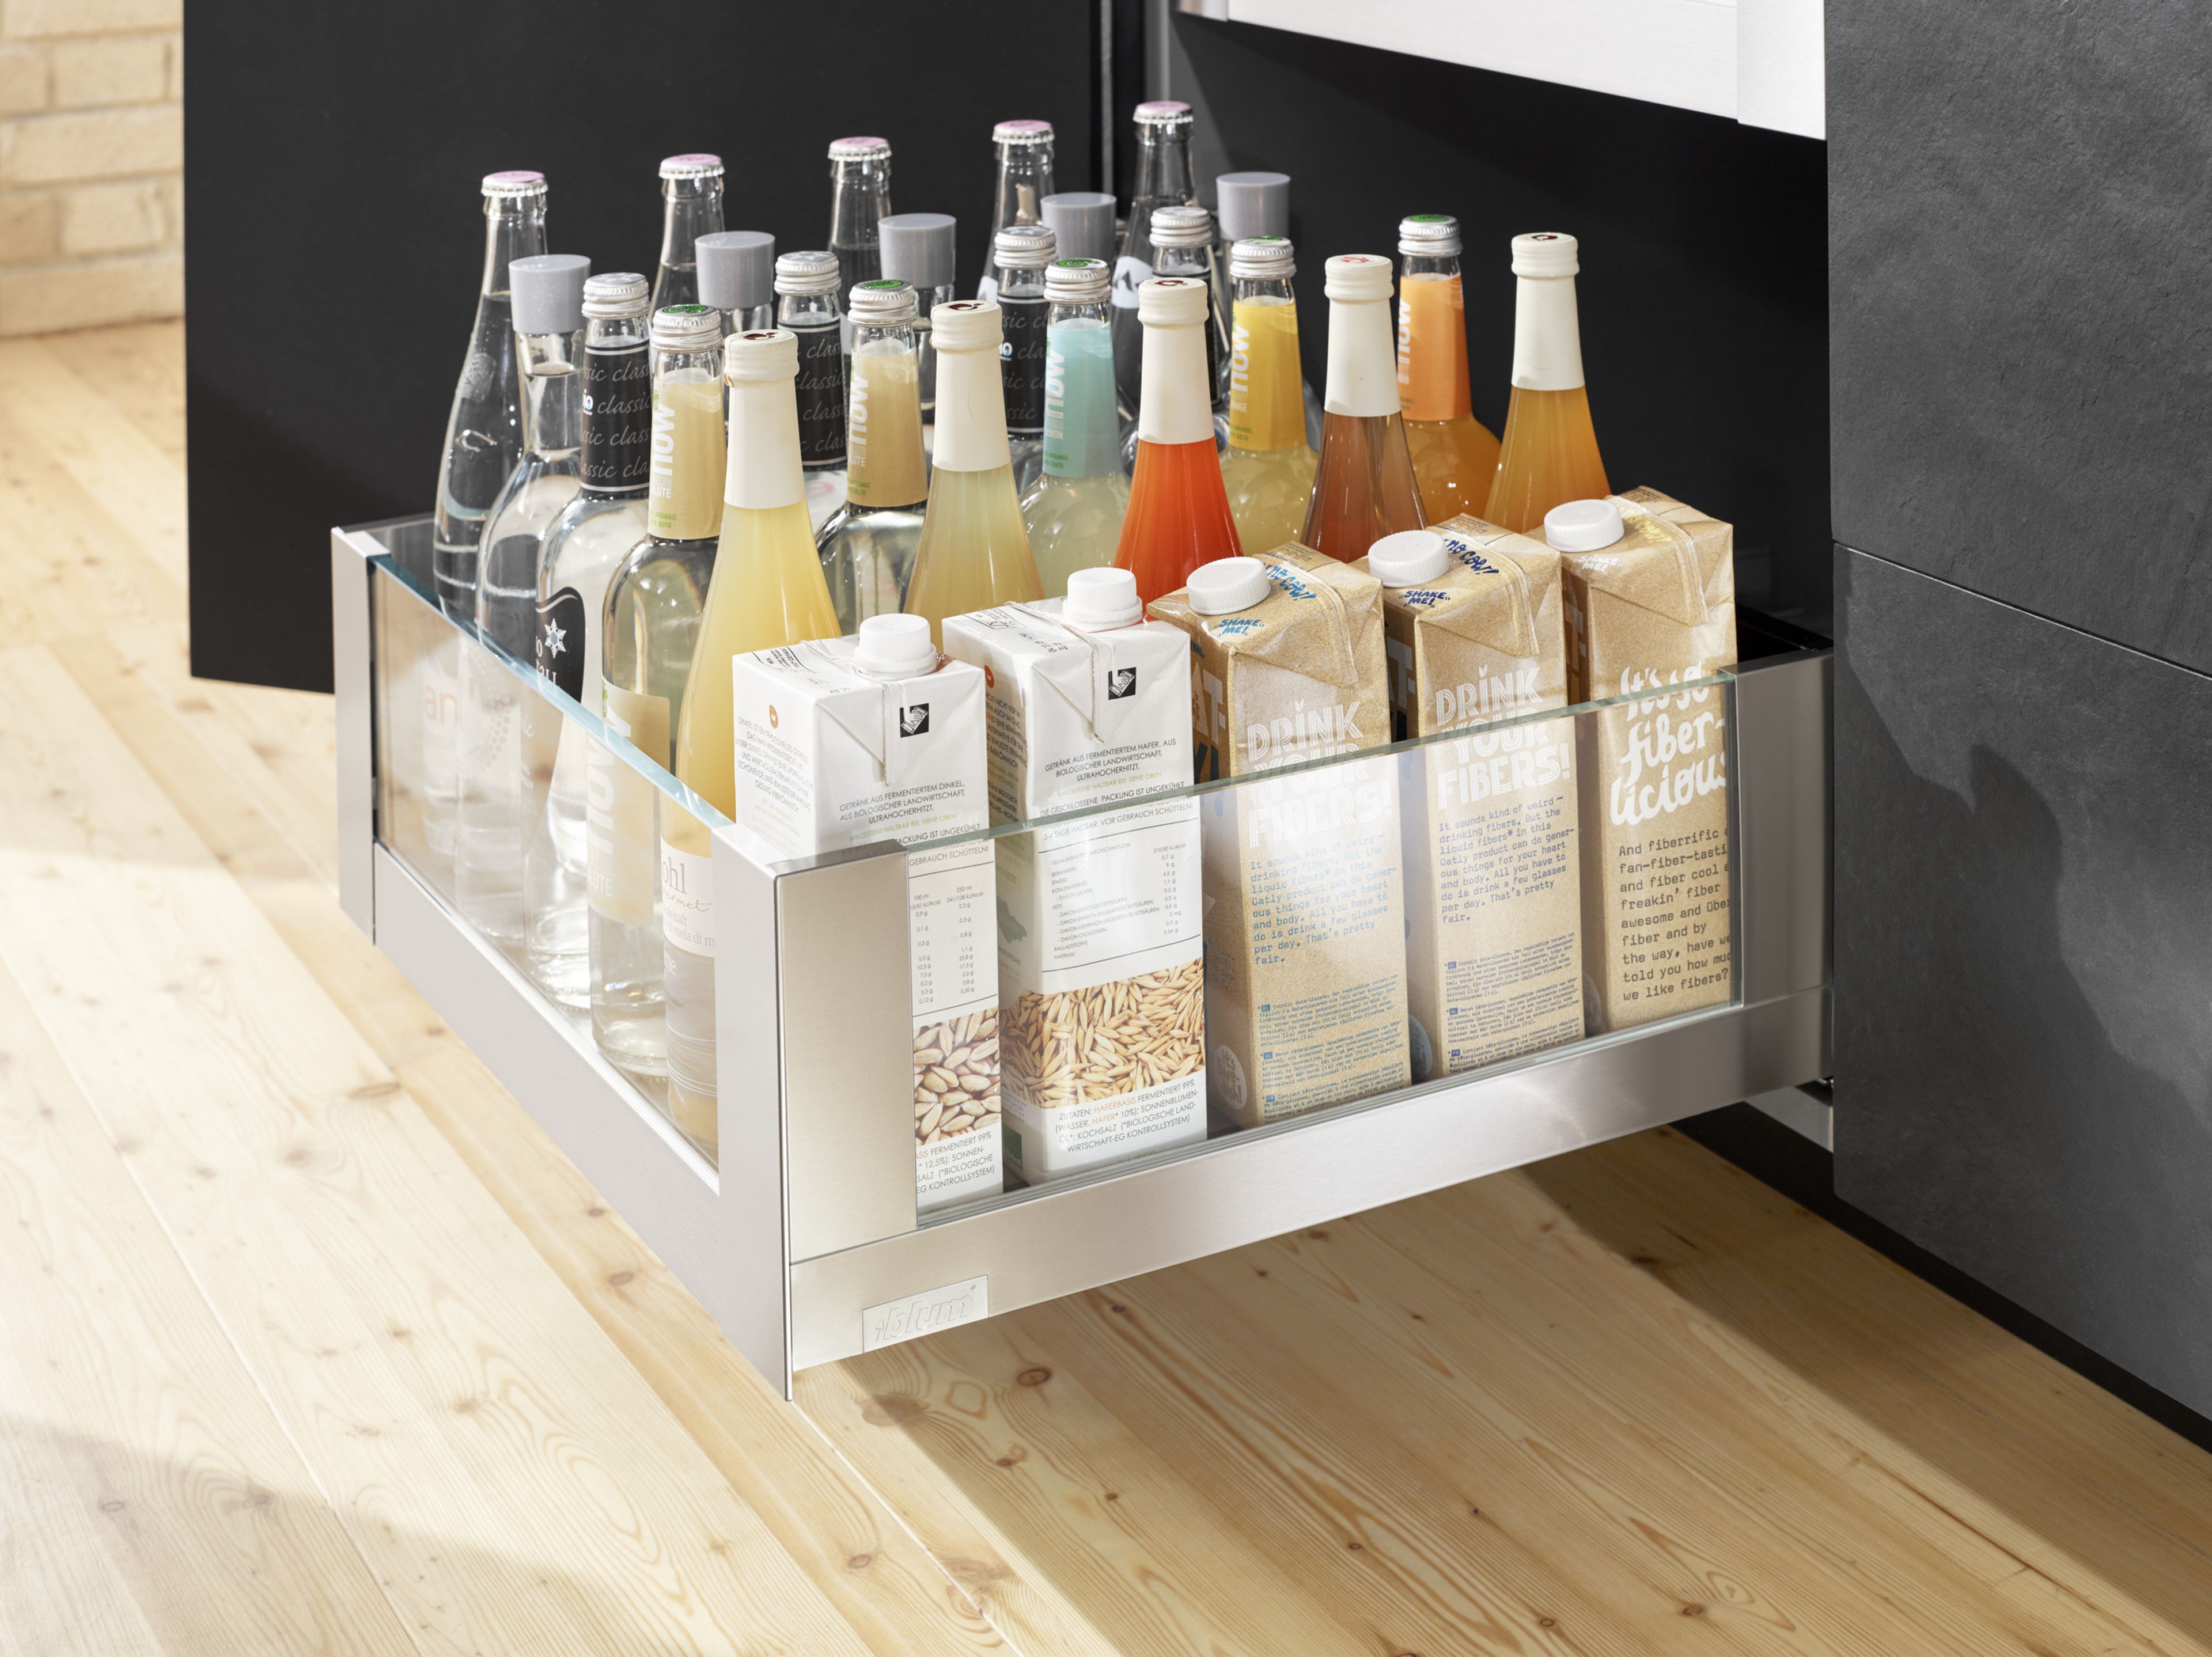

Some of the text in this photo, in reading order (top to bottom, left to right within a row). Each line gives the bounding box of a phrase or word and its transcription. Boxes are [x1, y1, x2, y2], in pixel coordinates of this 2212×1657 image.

[1404, 591, 1446, 599] SHAKE
[1222, 626, 1249, 634] ME!
[1436, 664, 1543, 726] DRINK
[1247, 699, 1363, 763] DRINK
[1045, 757, 1071, 772] GETRÄNK
[1073, 754, 1084, 763] AUS
[1086, 745, 1137, 760] FERMENTIERTEM
[1056, 761, 1101, 778] BIOLOGISCHER
[1077, 763, 1140, 781] ULTRAHOCHERHITZT.
[1438, 743, 1571, 810] FIBERS!
[840, 798, 869, 812] GETRÄNK
[870, 794, 884, 803] AUS
[885, 784, 938, 801] FERMENTIERTEM
[1101, 790, 1135, 802] PACKUNG
[1146, 782, 1184, 794] UNGEKÜHLT
[840, 812, 853, 822] AUS
[854, 801, 902, 818] BIOLOGISCHER
[869, 804, 934, 824] ULTRAHOCHERHITZT.
[1117, 809, 1154, 823] GEBRAUCH
[1455, 816, 1486, 829] sounds
[1489, 809, 1510, 820] kind
[1513, 804, 1523, 813] of
[930, 830, 938, 838] IST
[940, 824, 980, 836] UNGEKÜHLT
[1440, 828, 1483, 843] drinking
[1546, 807, 1560, 817] the
[1440, 842, 1474, 855] liquid
[1531, 822, 1552, 833] this
[1473, 844, 1508, 862] product
[1513, 841, 1528, 850] can
[1532, 836, 1542, 845] do
[1619, 829, 1719, 856] And fiberrific
[909, 850, 948, 867] GEBRAUCH
[1441, 841, 1566, 878] ous things for your heart
[1441, 854, 1566, 889] and body. All you have to
[1441, 893, 1453, 901] do
[1458, 889, 1469, 898] is
[1474, 882, 1500, 895] drink
[1513, 874, 1528, 885] few
[1532, 865, 1566, 881] glasses
[1620, 864, 1719, 892] and fiber cool
[1442, 903, 1459, 914] per
[1464, 898, 1486, 909] day.
[1525, 879, 1554, 896] pretty
[1687, 883, 1720, 899] fiber
[1442, 913, 1471, 924] fair.
[1622, 912, 1674, 928] awesome
[1680, 905, 1701, 918] and
[1623, 922, 1707, 947] fiber and by
[1623, 953, 1646, 965] the
[1652, 948, 1680, 961] way,
[1687, 938, 1714, 953] have
[1623, 969, 1654, 983] told
[1660, 964, 1681, 979] you
[1687, 958, 1708, 970] how
[1623, 968, 1729, 1001] we like fibers?
[1094, 1097, 1137, 1113] HAFERBASIS
[1138, 1084, 1181, 1102] FERMENTIERT
[1183, 1079, 1195, 1089] 99%
[1077, 1125, 1117, 1139] KOCHSALZ
[1127, 1114, 1190, 1138] KONTROLLSYSTEM)
[931, 1131, 991, 1155] FERMENTIERT 99%
[952, 1146, 985, 1162] SONNEN-
[929, 1165, 994, 1190] KONTROLLSYSTEM)
[883, 1295, 972, 1340] blum
